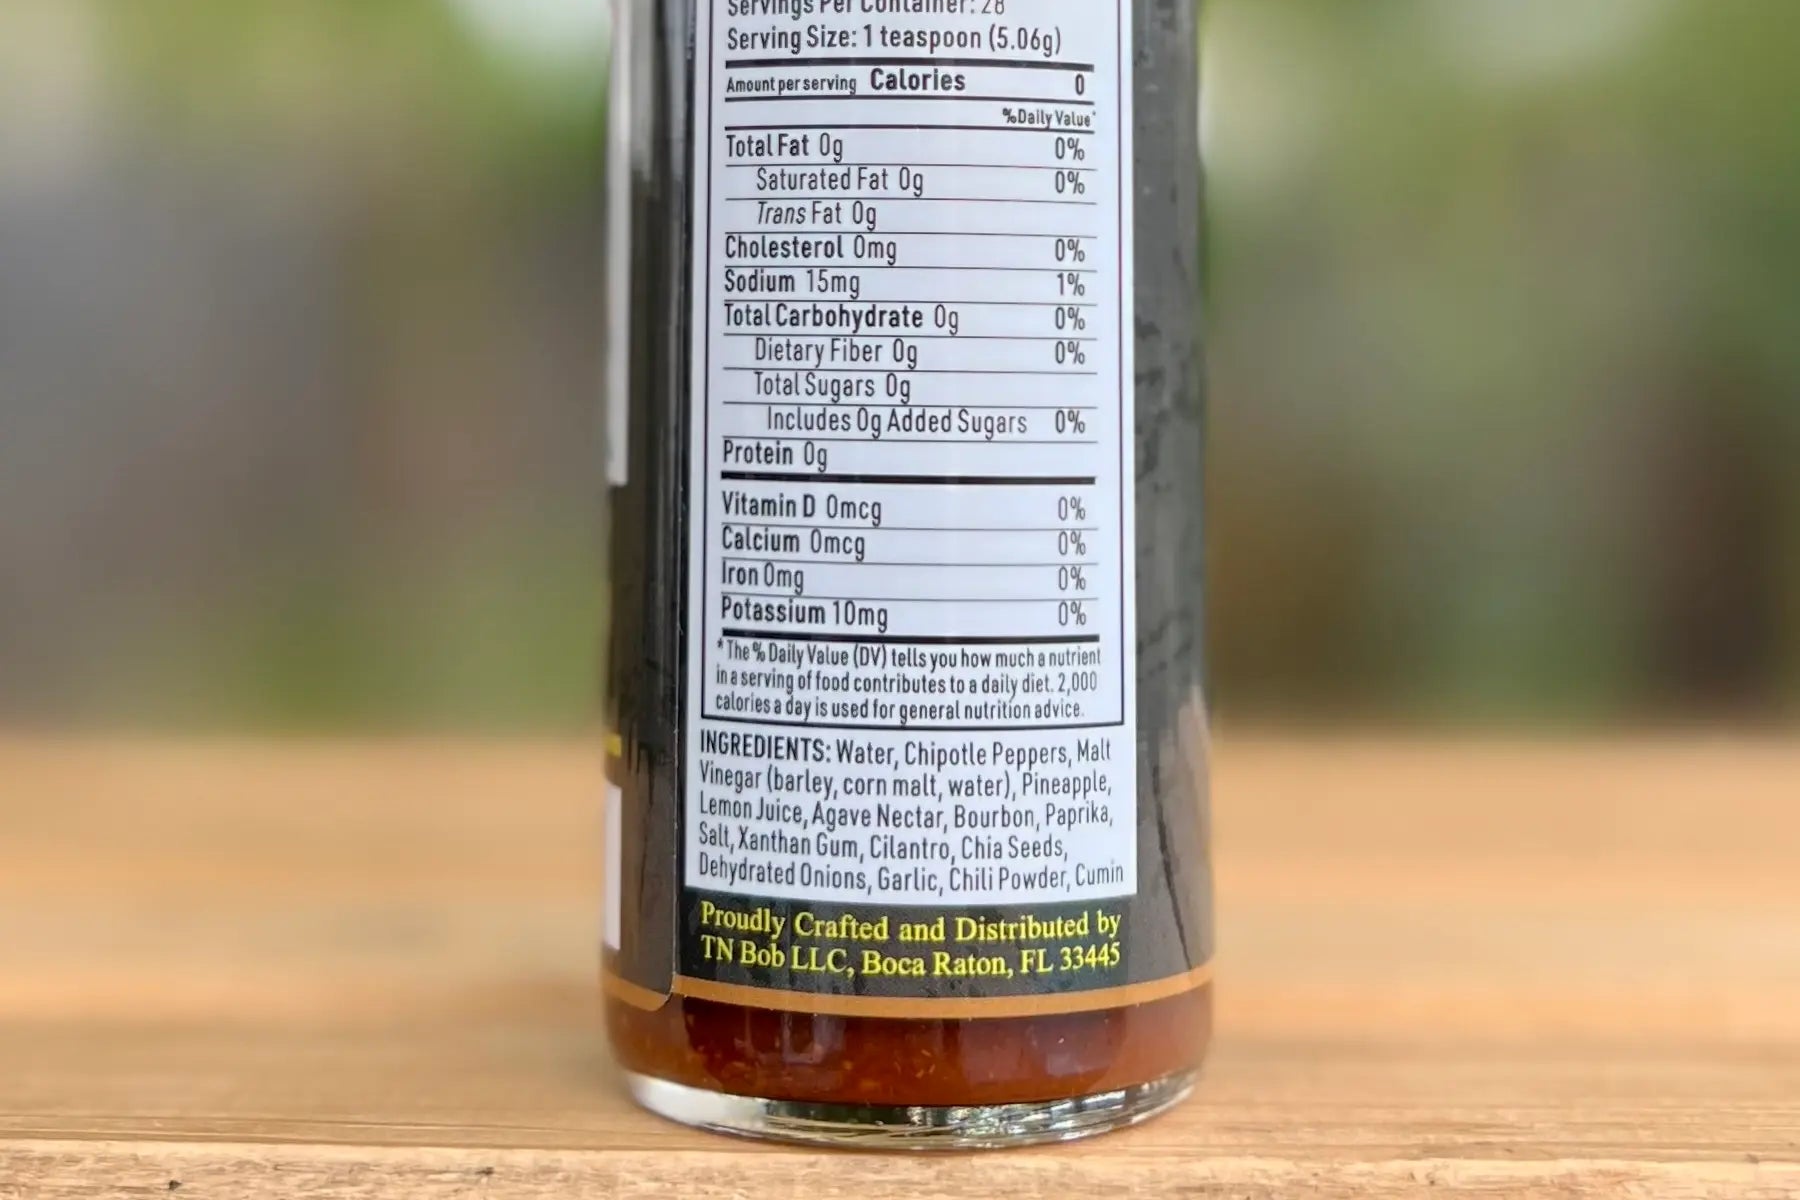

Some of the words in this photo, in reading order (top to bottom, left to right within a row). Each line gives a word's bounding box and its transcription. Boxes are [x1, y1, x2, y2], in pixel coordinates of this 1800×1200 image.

[727, 27, 801, 55] Serving
[806, 25, 857, 47] Size:
[864, 25, 872, 47] 1
[880, 25, 981, 53] teaspoon
[989, 27, 1061, 57] (5.06g)
[727, 76, 775, 92] Amount
[778, 78, 801, 96] per
[803, 76, 856, 94] serving
[870, 68, 966, 91] Calories
[1075, 75, 1084, 96] 0
[727, 134, 773, 157] Total
[778, 134, 809, 156] Fat
[819, 132, 843, 163] 0g
[1055, 137, 1085, 160] 0%
[757, 167, 851, 191] Saturated
[858, 167, 888, 190] Fat
[899, 167, 924, 197] 0g
[1055, 171, 1085, 194] 0%
[757, 201, 806, 225] Trans
[812, 201, 842, 224] Fat
[852, 201, 877, 231] 0g
[725, 235, 844, 259] Cholesterol
[854, 236, 897, 265] 0mg
[1055, 238, 1085, 261] 0%
[725, 269, 795, 293] Sodium
[807, 269, 860, 300] 15mg
[1057, 273, 1085, 296] 1%
[724, 303, 771, 327] Total
[776, 303, 923, 333] Carbohydrate
[934, 304, 959, 335] 0g
[1055, 307, 1085, 331] 0%
[755, 337, 824, 368] Dietary
[831, 339, 882, 362] Fiber
[892, 338, 918, 369] 0g
[1055, 341, 1085, 364] 0%
[754, 372, 800, 396] Total
[805, 372, 875, 403] Sugars
[886, 373, 911, 404] 0g
[767, 406, 851, 431] Includes
[857, 408, 881, 439] 0g
[887, 408, 951, 433] Added
[958, 409, 1027, 441] Sugars
[1055, 410, 1085, 434] 0%
[724, 440, 793, 465] Protein
[803, 441, 827, 472] 0g
[722, 491, 796, 517] Vitamin
[803, 494, 816, 518] D
[826, 495, 882, 526] 0mcg
[1058, 497, 1085, 521] 0%
[722, 525, 800, 552] Calcium
[810, 529, 865, 562] 0mcg
[1058, 531, 1086, 556] 0%
[722, 561, 758, 586] Iron
[764, 563, 804, 595] 0mg
[1058, 566, 1086, 591] 0%
[721, 596, 825, 624] Potassium
[833, 600, 888, 633] 10mg
[1058, 601, 1086, 626] 0%
[727, 640, 749, 660] The
[753, 644, 765, 662] %
[769, 643, 803, 668] Daily
[807, 645, 848, 665] Value
[853, 645, 887, 670] (DV)
[891, 646, 926, 667] tells
[930, 651, 957, 673] you
[961, 647, 990, 667] how
[995, 647, 1035, 668] much
[1038, 653, 1045, 666] a
[1049, 647, 1100, 666] nutrient
[716, 667, 727, 684] in
[730, 672, 738, 686] a
[741, 672, 794, 693] serving
[799, 671, 814, 690] of
[815, 672, 850, 691] food
[853, 674, 946, 694] contributes
[950, 675, 965, 694] to
[969, 679, 977, 694] a
[981, 674, 1018, 698] daily
[1021, 673, 1054, 693] diet.
[1058, 671, 1098, 696] 2,000
[716, 693, 771, 713] calories
[775, 699, 782, 714] a
[786, 696, 811, 722] day
[815, 698, 828, 716] is
[831, 698, 869, 718] used
[873, 699, 896, 718] for
[899, 700, 961, 724] general
[964, 700, 1031, 720] nutrition
[1034, 699, 1084, 718] advice.
[700, 729, 832, 763] INGREDIENTS:
[836, 738, 899, 771] Water,
[904, 742, 987, 770] Chipotle
[992, 741, 1072, 772] Peppers,
[1077, 739, 1110, 761] Malt
[700, 761, 761, 793] Vinegar
[767, 764, 838, 802] (barley,
[843, 776, 887, 795] corn
[893, 773, 942, 800] malt,
[948, 772, 1015, 803] water),
[1022, 768, 1112, 798] Pineapple,
[700, 792, 753, 819] Lemon
[756, 797, 807, 829] Juice,
[812, 806, 872, 834] Agave
[877, 805, 948, 832] Nectar,
[954, 805, 1040, 832] Bourbon,
[1046, 802, 1113, 831] Paprika,
[699, 823, 736, 852] Salt,
[739, 828, 811, 856] Xanthan
[816, 835, 864, 861] Gum,
[870, 835, 955, 864] Cilantro,
[961, 835, 1003, 859] Chia
[1007, 834, 1068, 861] Seeds,
[699, 852, 795, 887] Dehydrated
[800, 864, 871, 895] Onions,
[878, 867, 943, 895] Garlic,
[949, 866, 993, 890] Chili
[999, 864, 1070, 891] Powder,
[1076, 860, 1123, 887] Cumin
[702, 901, 786, 939] Proudly
[795, 912, 889, 941] Crafted
[900, 916, 945, 942] and
[955, 911, 1090, 942] Distributed
[1096, 910, 1121, 937] by
[701, 936, 735, 961] TN
[739, 942, 785, 968] Bob
[791, 945, 856, 978] LLC,
[862, 949, 925, 976] Boca
[933, 950, 1013, 978] Raton,
[1019, 948, 1054, 973] FL
[1060, 941, 1121, 968] 33445
